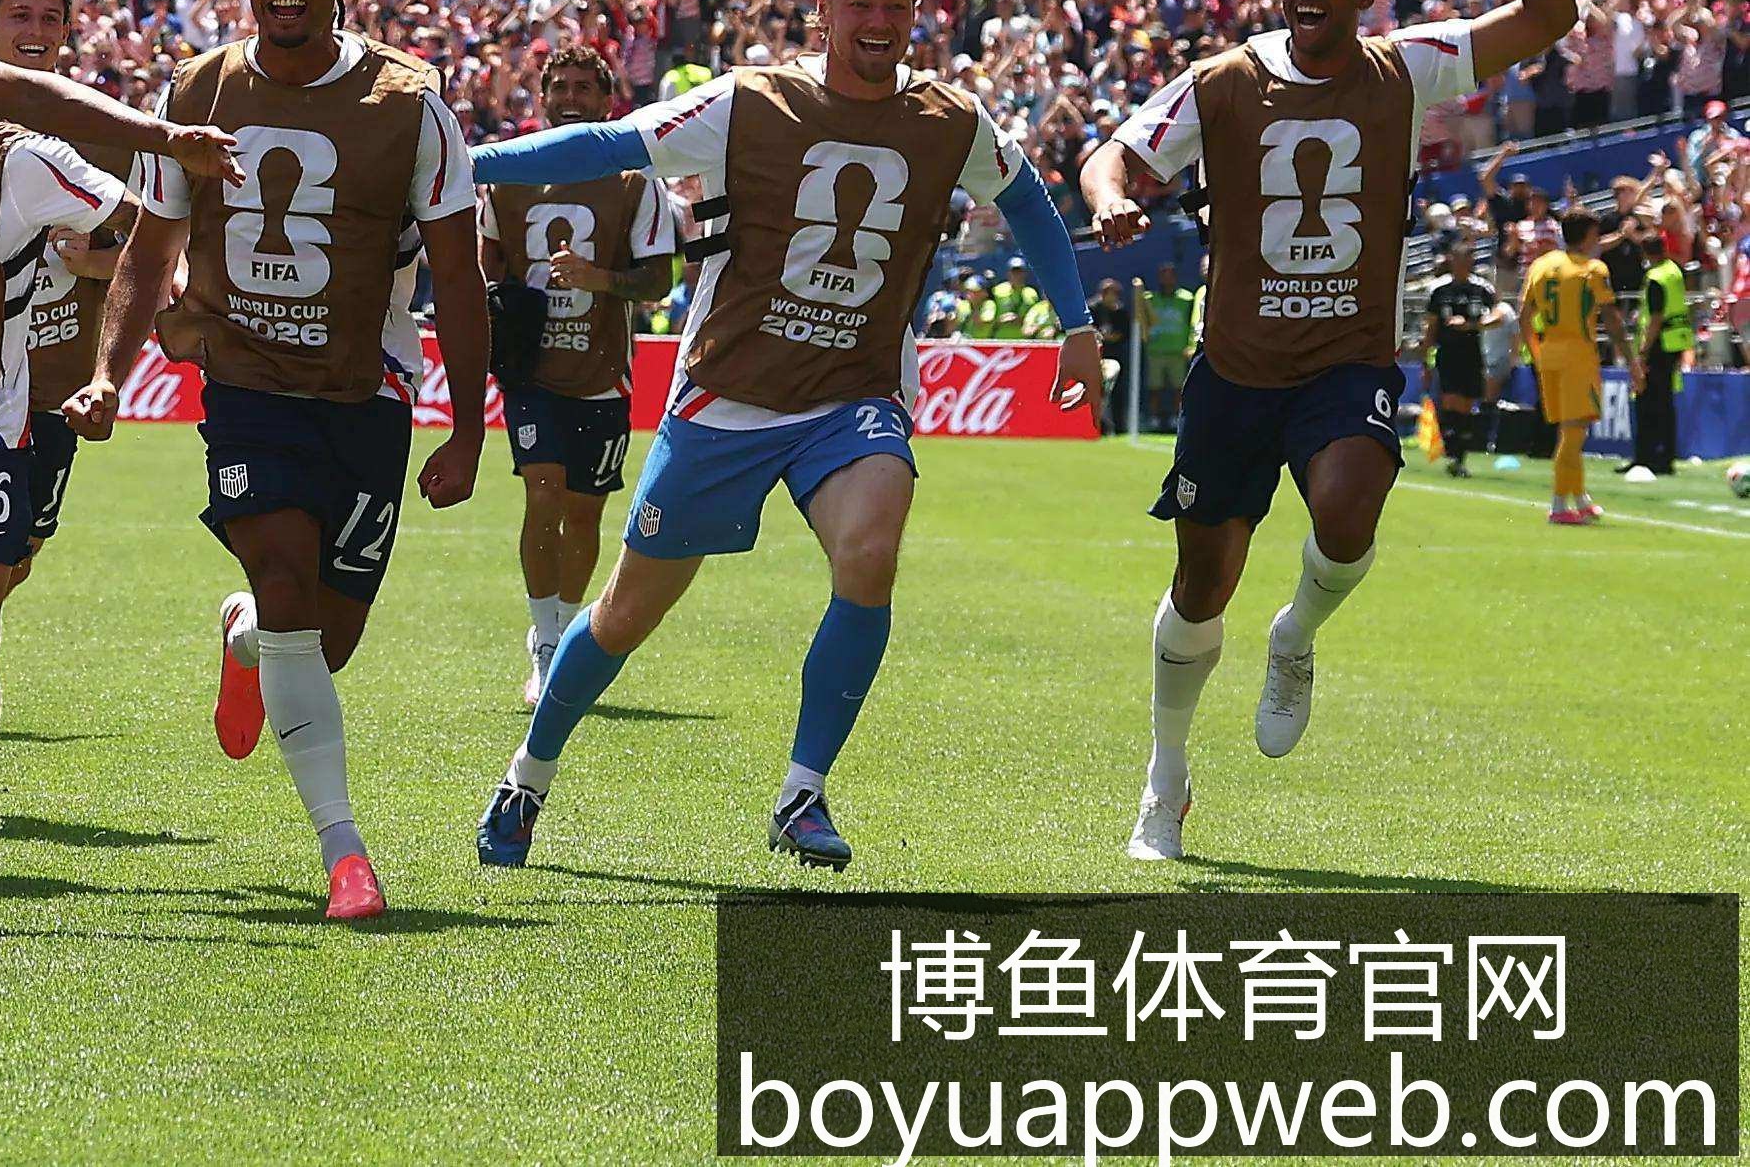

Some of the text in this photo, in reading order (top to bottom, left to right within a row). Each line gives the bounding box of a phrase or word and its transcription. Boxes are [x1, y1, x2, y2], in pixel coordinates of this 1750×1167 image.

[1290, 244, 1336, 261] FIFA
[252, 260, 300, 282] FIFA
[809, 269, 856, 293] FIFA
[1261, 278, 1359, 293] WORLD CUP
[51, 302, 79, 321] CUP
[227, 293, 329, 320] WORLD CUP
[769, 297, 868, 328] WORLD CUP
[1259, 294, 1359, 319] 2026
[27, 318, 80, 350] 026
[566, 322, 591, 333] CUP
[758, 314, 859, 350] 2026
[540, 332, 590, 352] 026
[1374, 389, 1392, 419] 6
[597, 433, 627, 475] 10
[334, 491, 395, 561] 12
